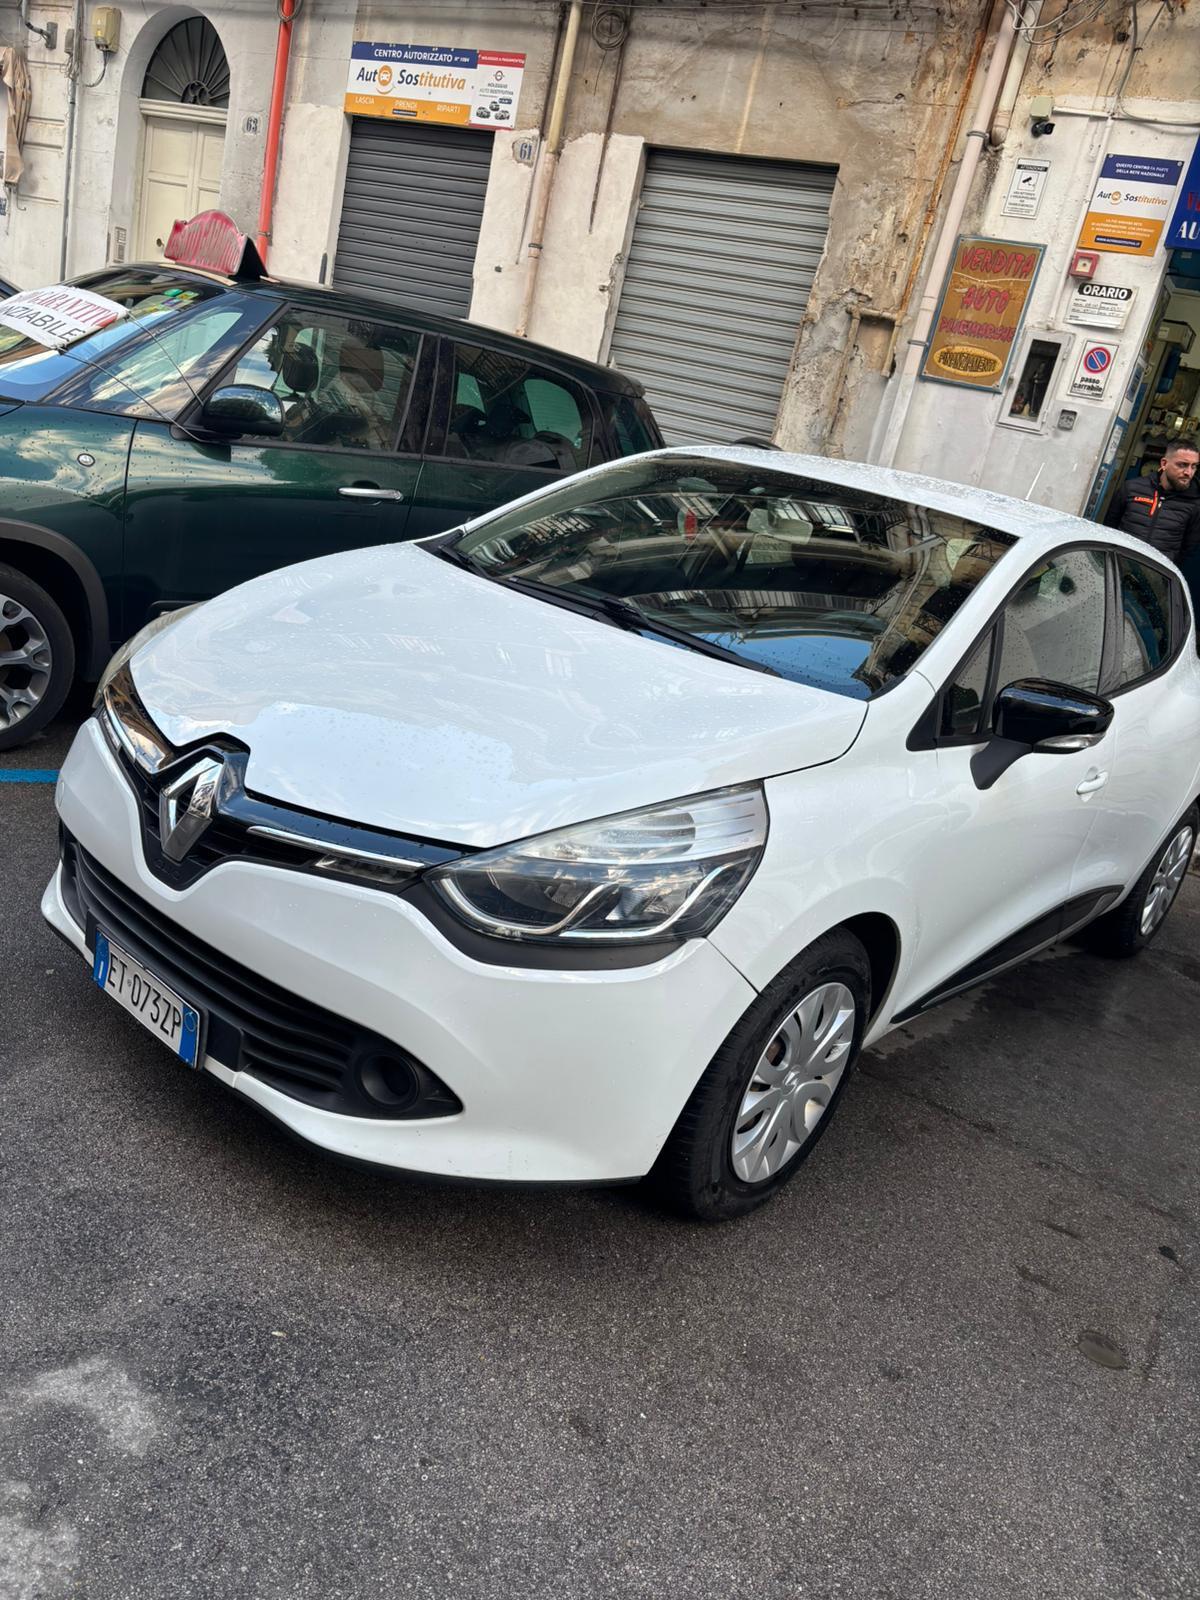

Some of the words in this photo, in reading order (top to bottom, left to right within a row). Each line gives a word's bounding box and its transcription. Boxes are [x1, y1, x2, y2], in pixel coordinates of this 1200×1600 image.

[374, 49, 402, 59] CENTRO
[403, 51, 453, 63] AUTORIZZATO
[397, 69, 466, 91] Sostitutiva
[355, 96, 375, 105] LASCIA
[394, 100, 417, 109] PRENDI
[437, 103, 461, 113] RIPARTI
[520, 143, 532, 160] 61
[1123, 193, 1168, 206] Sostitutiva
[960, 246, 1037, 279] VENDITA
[960, 284, 1010, 314] AUTO
[1082, 284, 1129, 300] ORARIO
[1073, 382, 1104, 393] carrabile
[1080, 376, 1101, 385] passo
